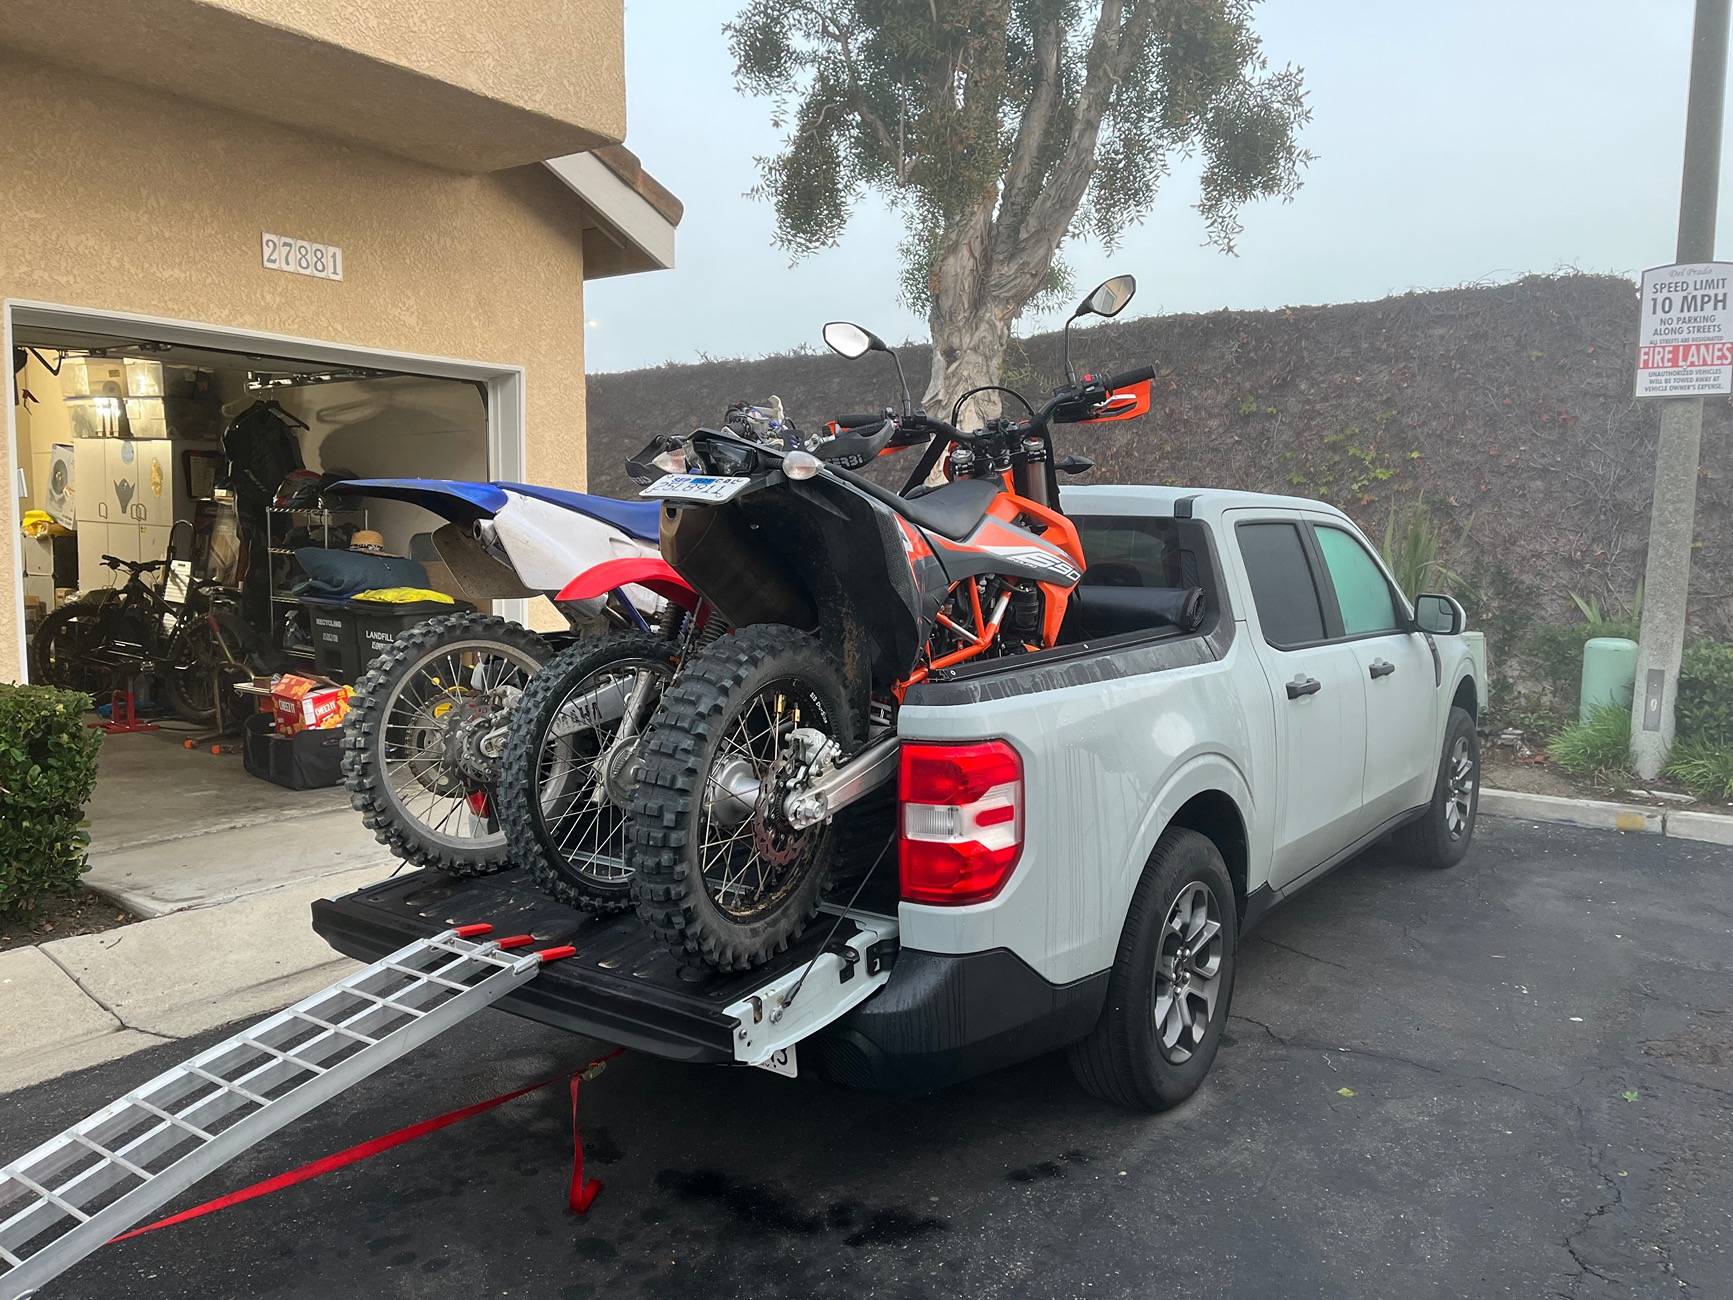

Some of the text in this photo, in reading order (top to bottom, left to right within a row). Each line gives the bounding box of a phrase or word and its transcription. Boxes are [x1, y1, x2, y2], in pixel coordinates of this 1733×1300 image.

[264, 239, 340, 276] 27881
[1652, 278, 1728, 294] SPEED LIMIT
[1651, 292, 1728, 315] 10 MPH
[1660, 315, 1716, 326] NO PARKING
[1653, 324, 1722, 336] ALONG STREETS
[1640, 343, 1732, 368] FIRE LANES
[365, 630, 394, 642] LANDFILL
